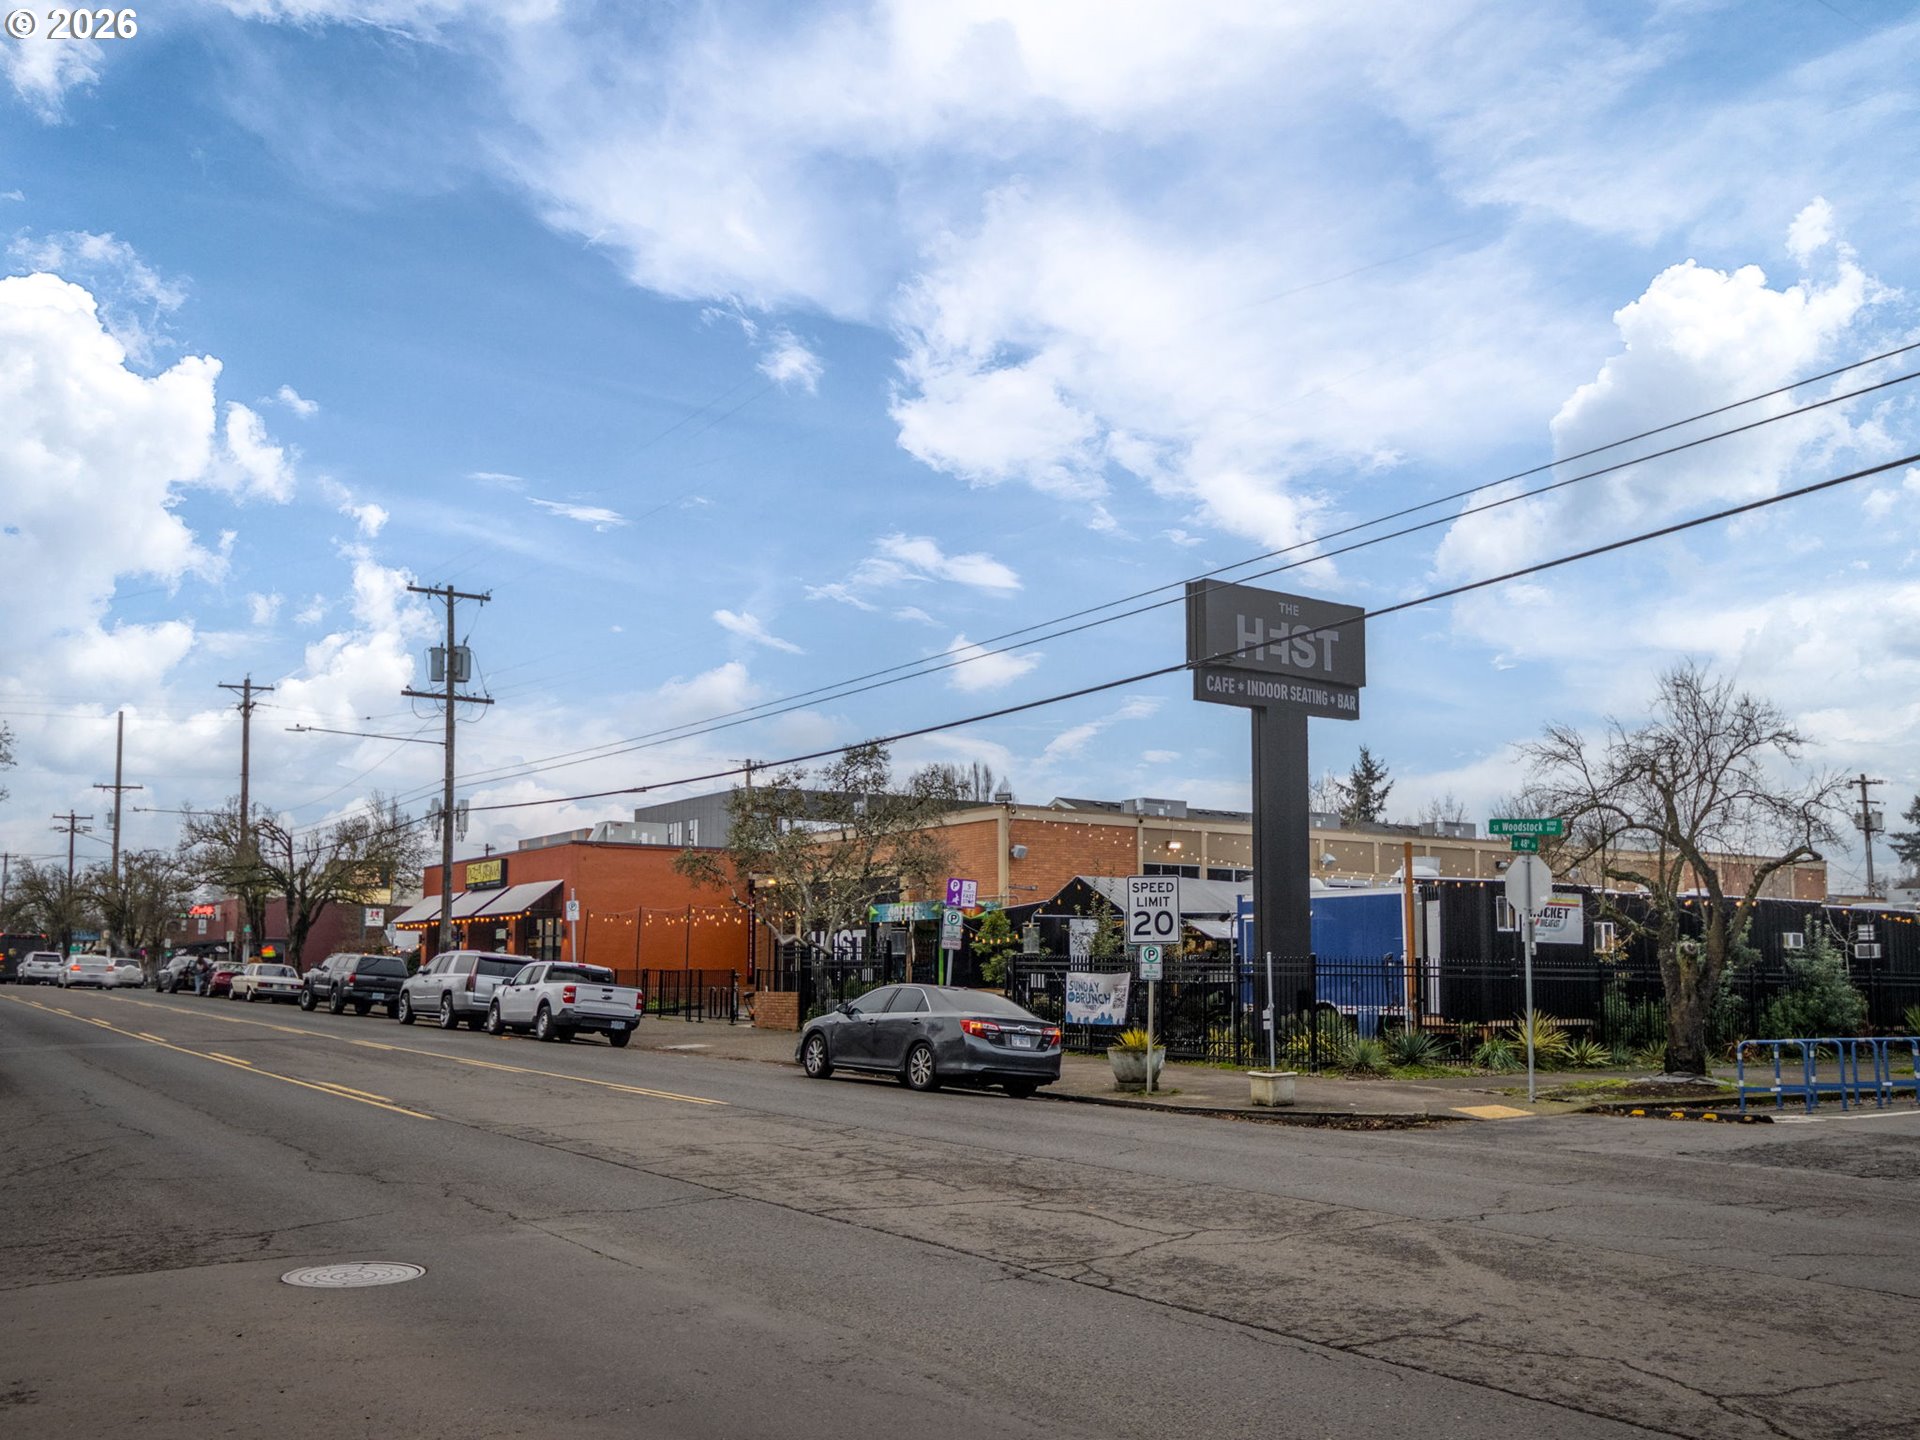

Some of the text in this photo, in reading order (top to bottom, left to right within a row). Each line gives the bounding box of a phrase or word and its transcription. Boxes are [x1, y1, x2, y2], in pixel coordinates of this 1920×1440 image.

[1278, 602, 1300, 617] THE
[1206, 675, 1356, 712] CAFE INDOOR SEATING BAR
[1502, 822, 1543, 832] Woodstock
[1132, 882, 1175, 893] SPEED
[1136, 897, 1170, 908] LIMIT
[1133, 910, 1174, 936] 20
[1148, 949, 1155, 959] P
[1068, 980, 1100, 993] SUNDAY
[1075, 992, 1111, 1005] BRUNCH
